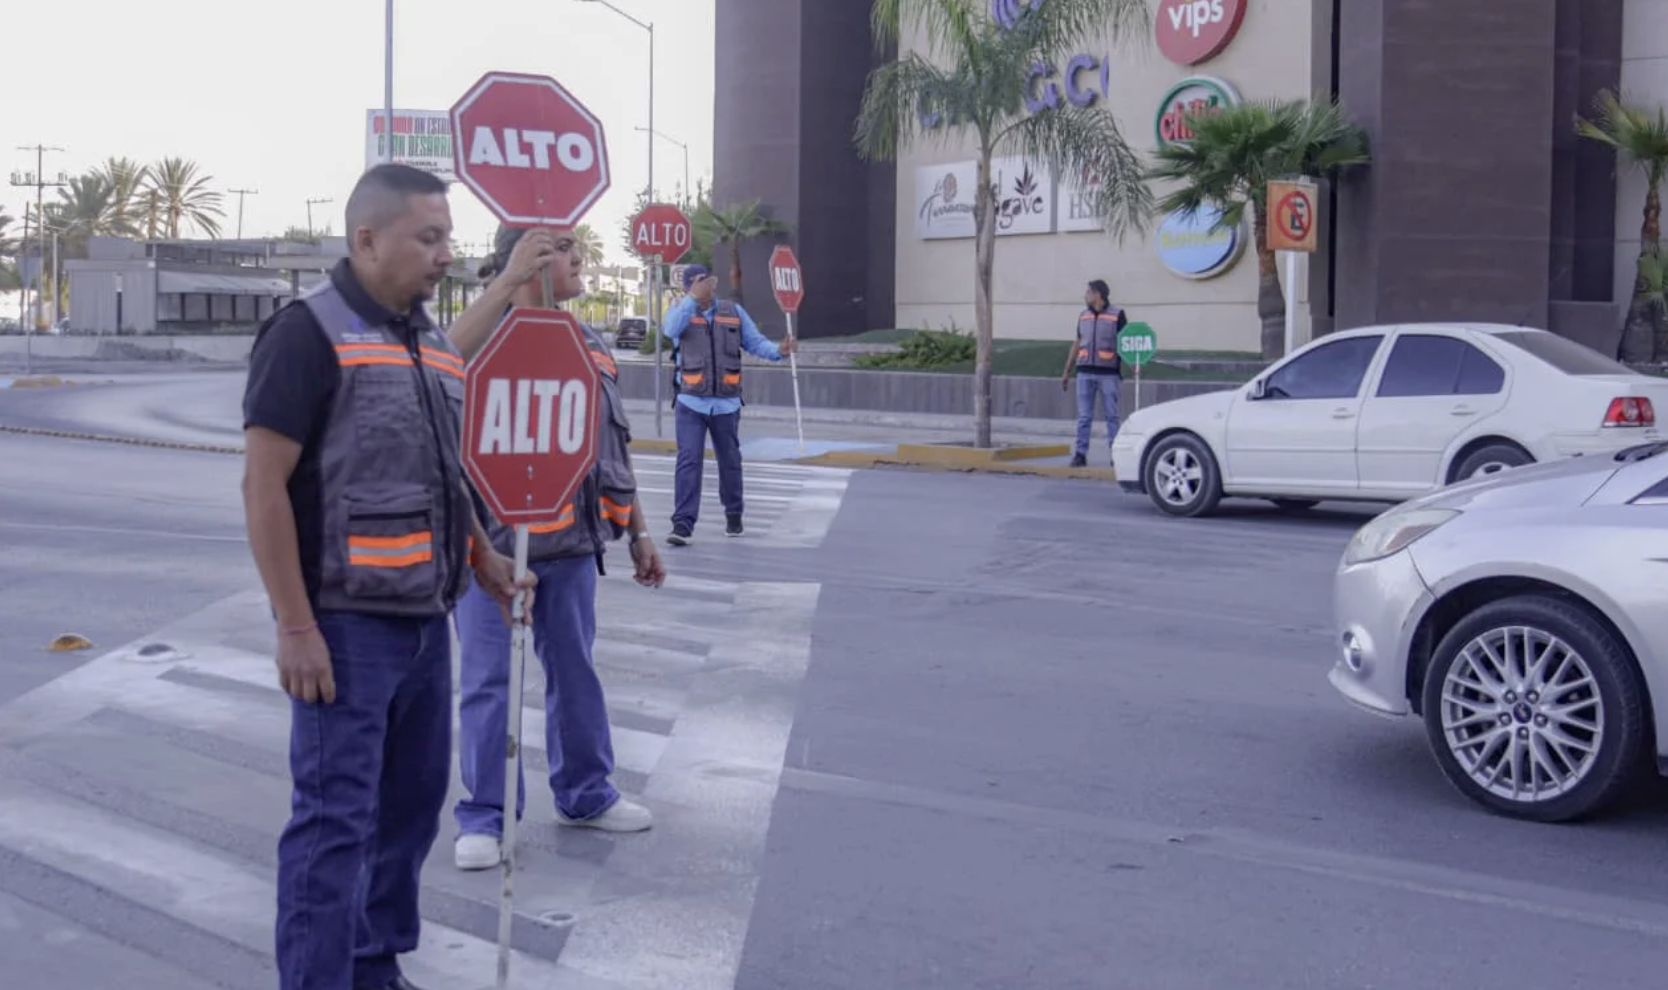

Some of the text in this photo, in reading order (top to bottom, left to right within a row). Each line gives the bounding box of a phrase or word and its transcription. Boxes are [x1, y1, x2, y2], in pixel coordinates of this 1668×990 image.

[1167, 0, 1224, 38] vips
[469, 126, 594, 172] ALTO
[636, 223, 687, 246] ALTO
[774, 267, 800, 292] ALTO
[1121, 335, 1153, 352] SIGA
[478, 378, 587, 454] ALTO
